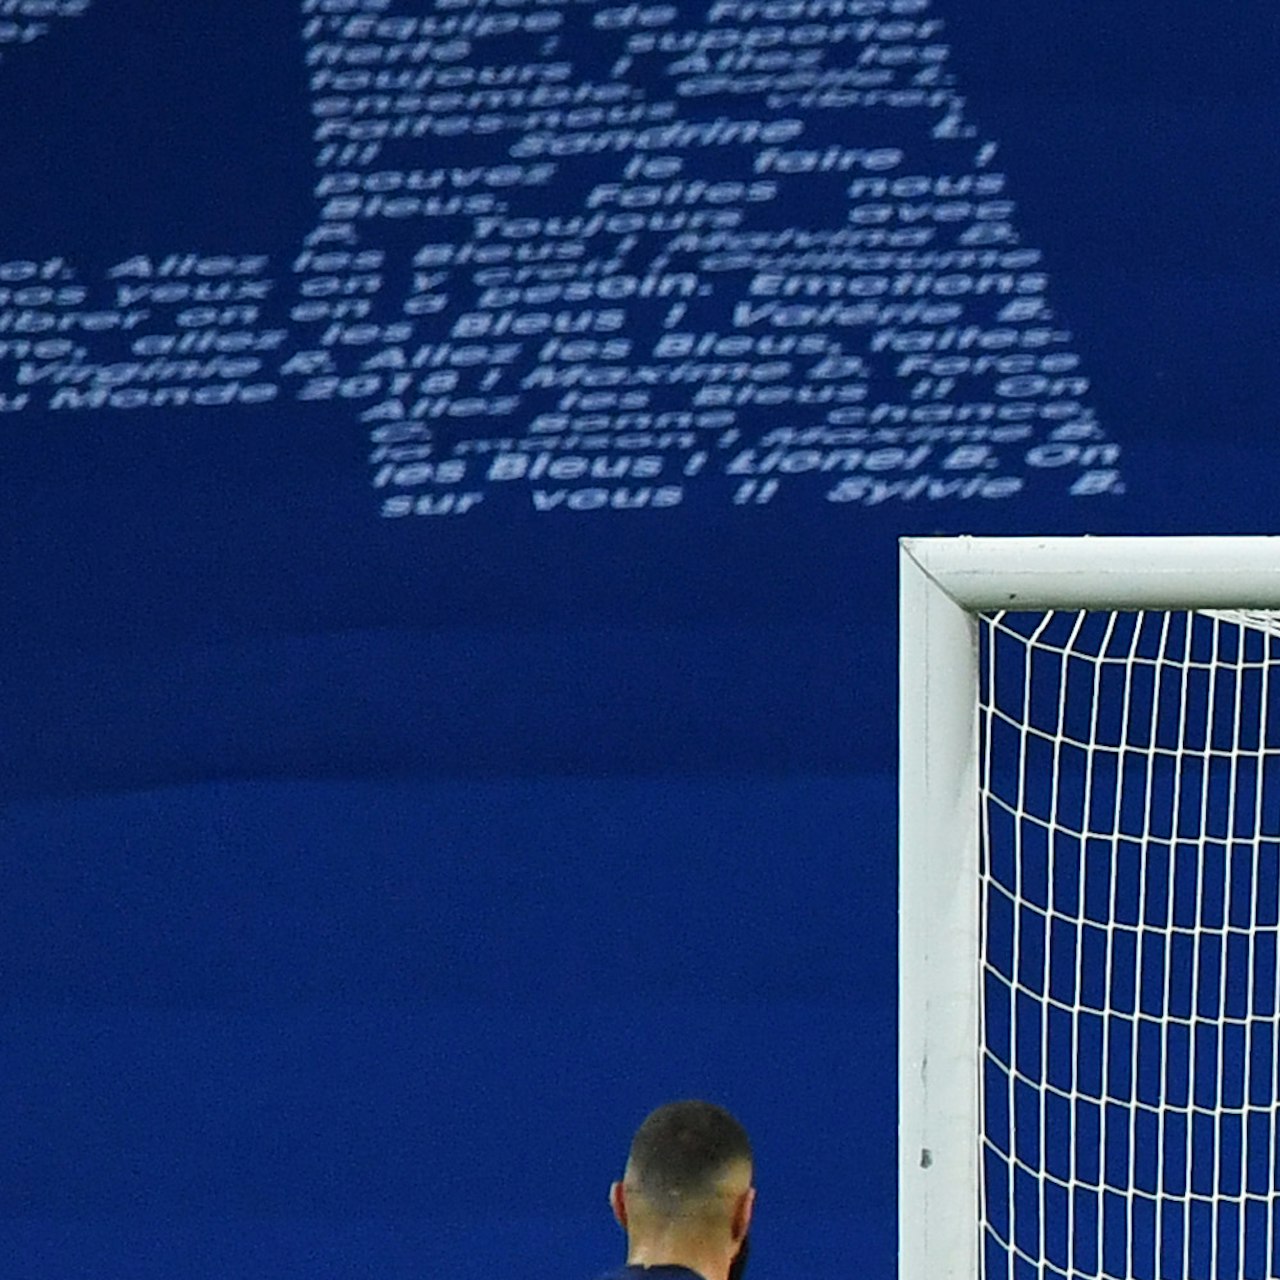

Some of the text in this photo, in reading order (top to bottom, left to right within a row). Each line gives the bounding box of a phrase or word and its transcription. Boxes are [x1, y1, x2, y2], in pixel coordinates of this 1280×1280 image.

[452, 309, 624, 339] Bleus
[374, 463, 465, 487] les
[487, 452, 662, 480] Bleus
[1026, 444, 1116, 467] On
[382, 493, 482, 517] sur
[533, 486, 682, 510] vous
